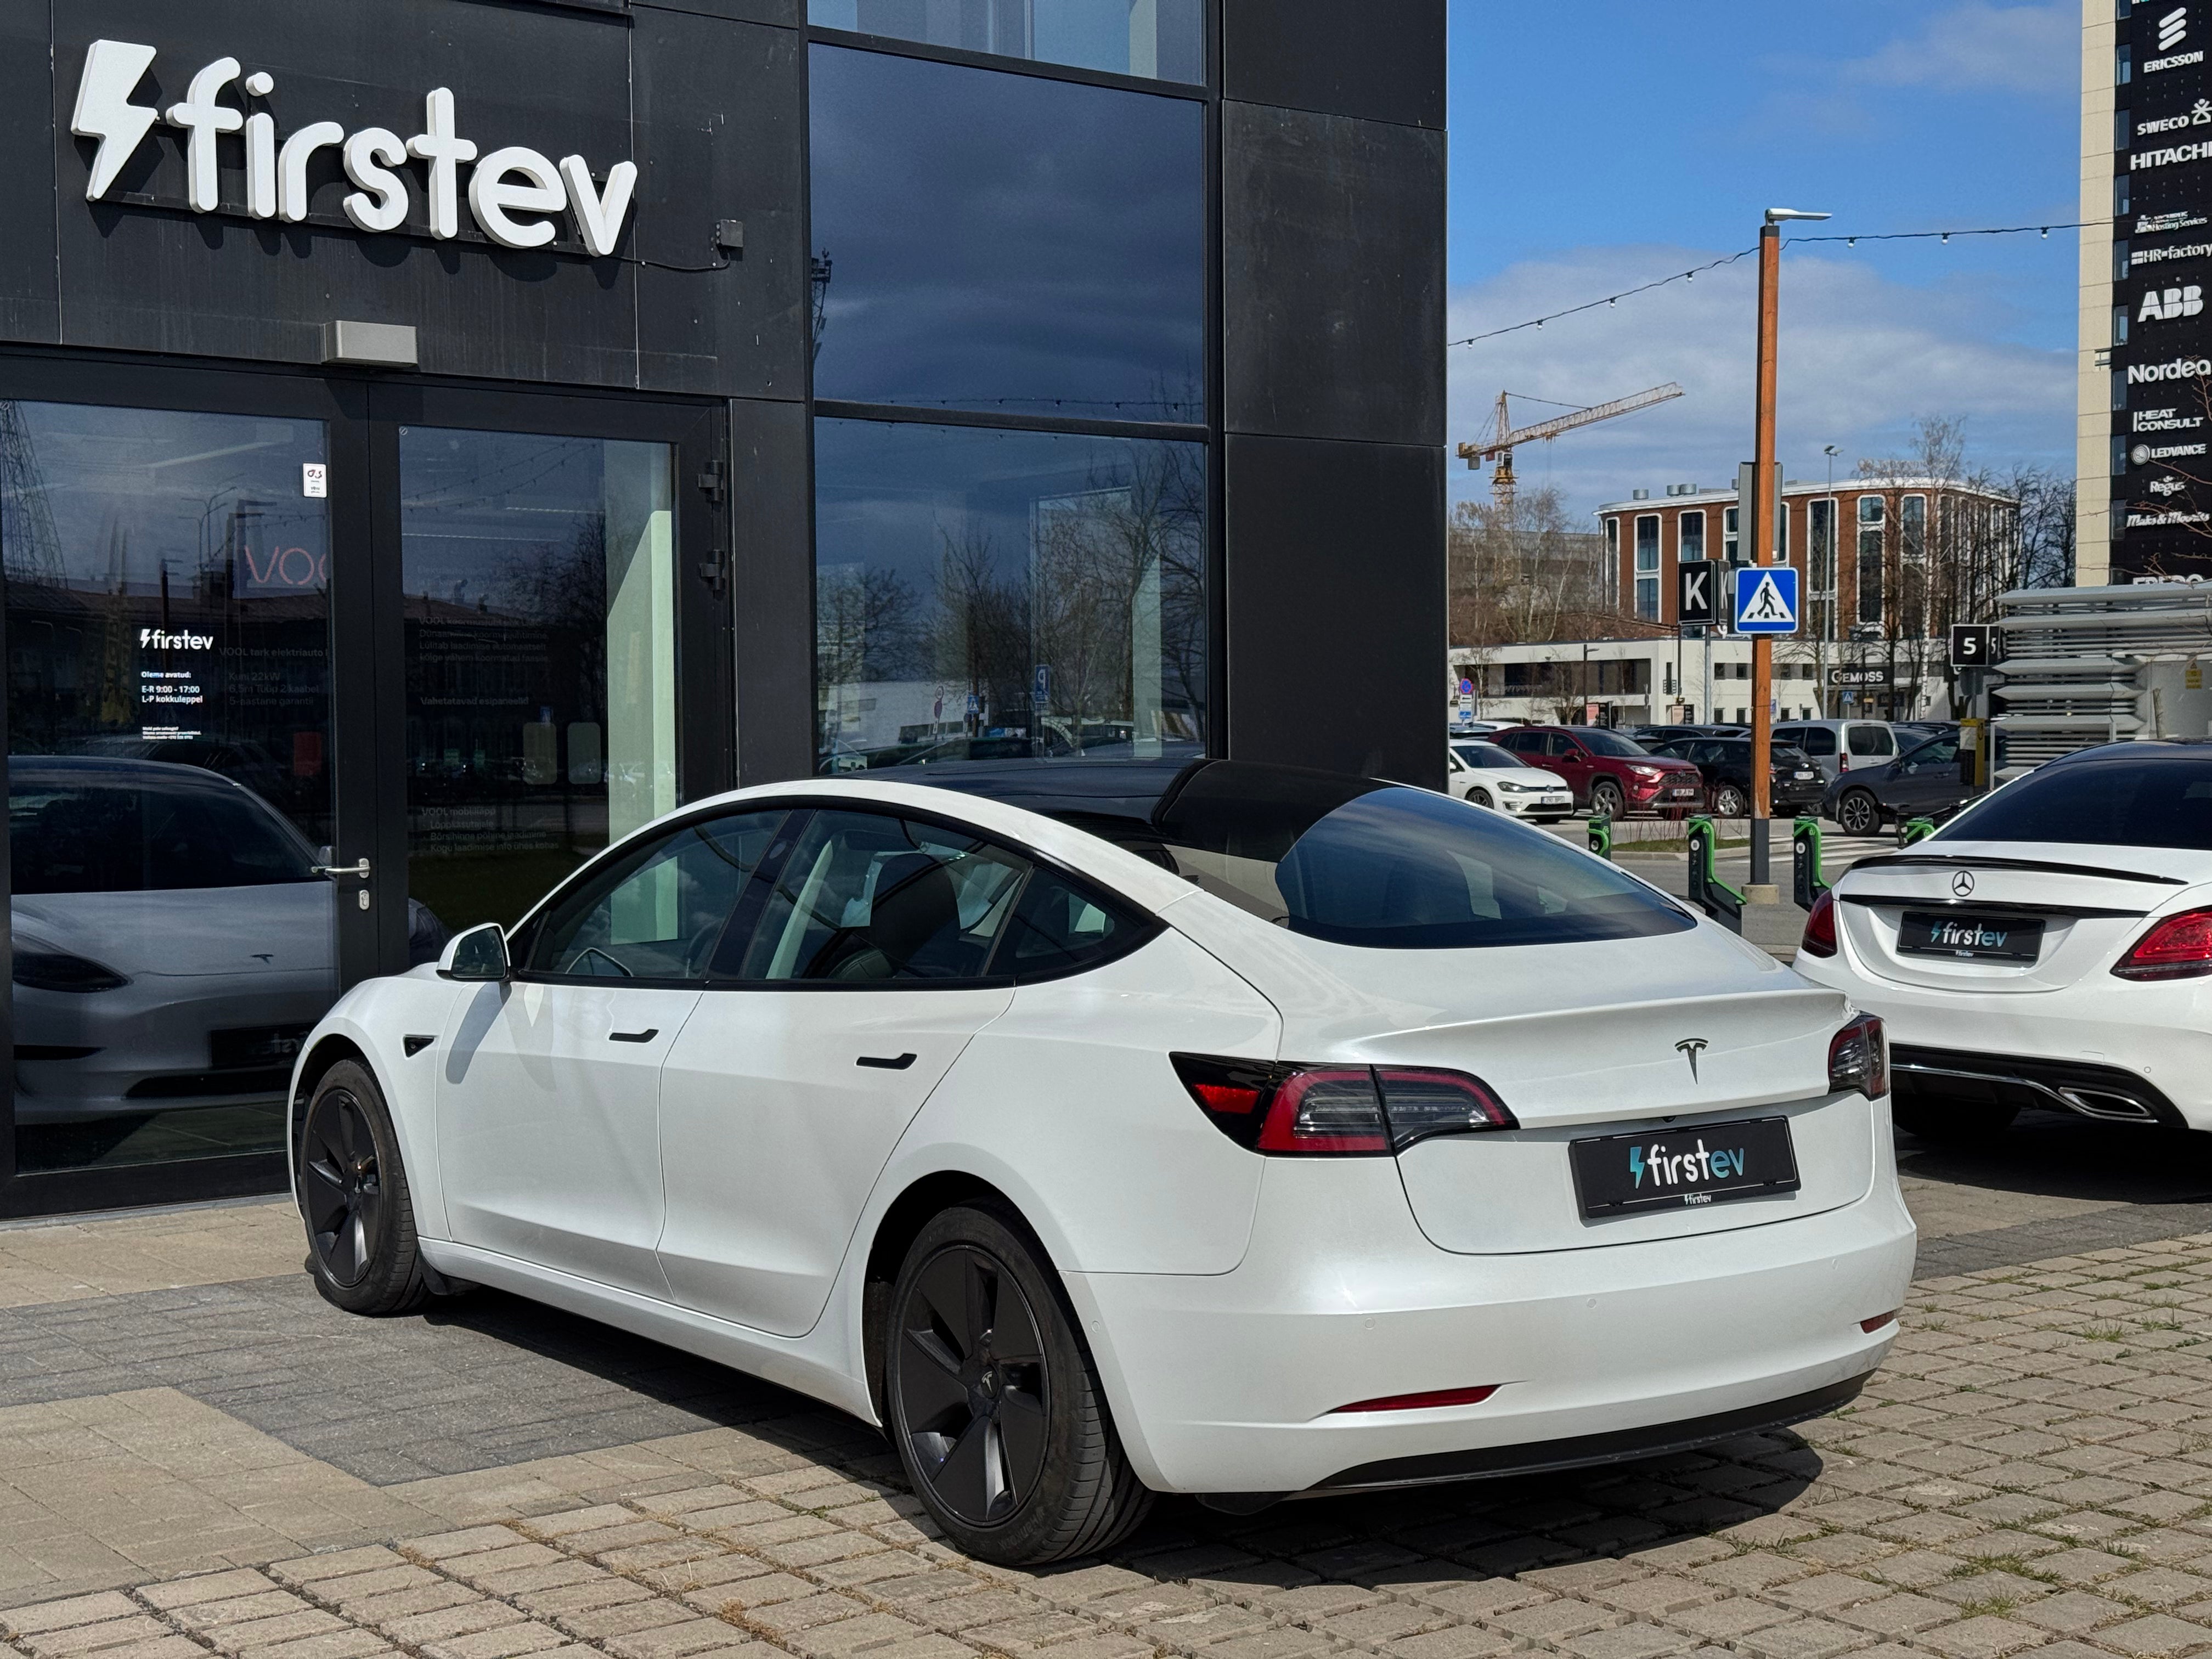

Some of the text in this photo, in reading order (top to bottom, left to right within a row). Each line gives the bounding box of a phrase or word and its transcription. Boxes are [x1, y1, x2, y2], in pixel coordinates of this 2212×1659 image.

[2144, 51, 2203, 73] ERICSSON
[2137, 116, 2189, 136] SWECO
[166, 57, 637, 257] firstev
[2130, 142, 2212, 170] HITACHI
[2137, 285, 2203, 323] ABB
[2128, 358, 2212, 384] Nordea
[2138, 417, 2204, 432] CONSULT
[2139, 408, 2177, 421] HEAT
[2151, 444, 2207, 458] LEDVANCE
[2149, 481, 2186, 496] Regus
[244, 545, 326, 585] VO
[1685, 572, 1708, 611] K
[1720, 572, 1728, 610] K
[152, 629, 213, 650] firstev
[1963, 637, 1977, 654] 5
[1991, 637, 1997, 654] 5
[271, 647, 324, 657] elektriauto
[179, 685, 200, 693] 17:00
[142, 695, 203, 704] L-P kokkuleppel
[1943, 922, 2007, 947] firstev
[1647, 1139, 1744, 1186] firstev
[1689, 1193, 1712, 1205] firstev
